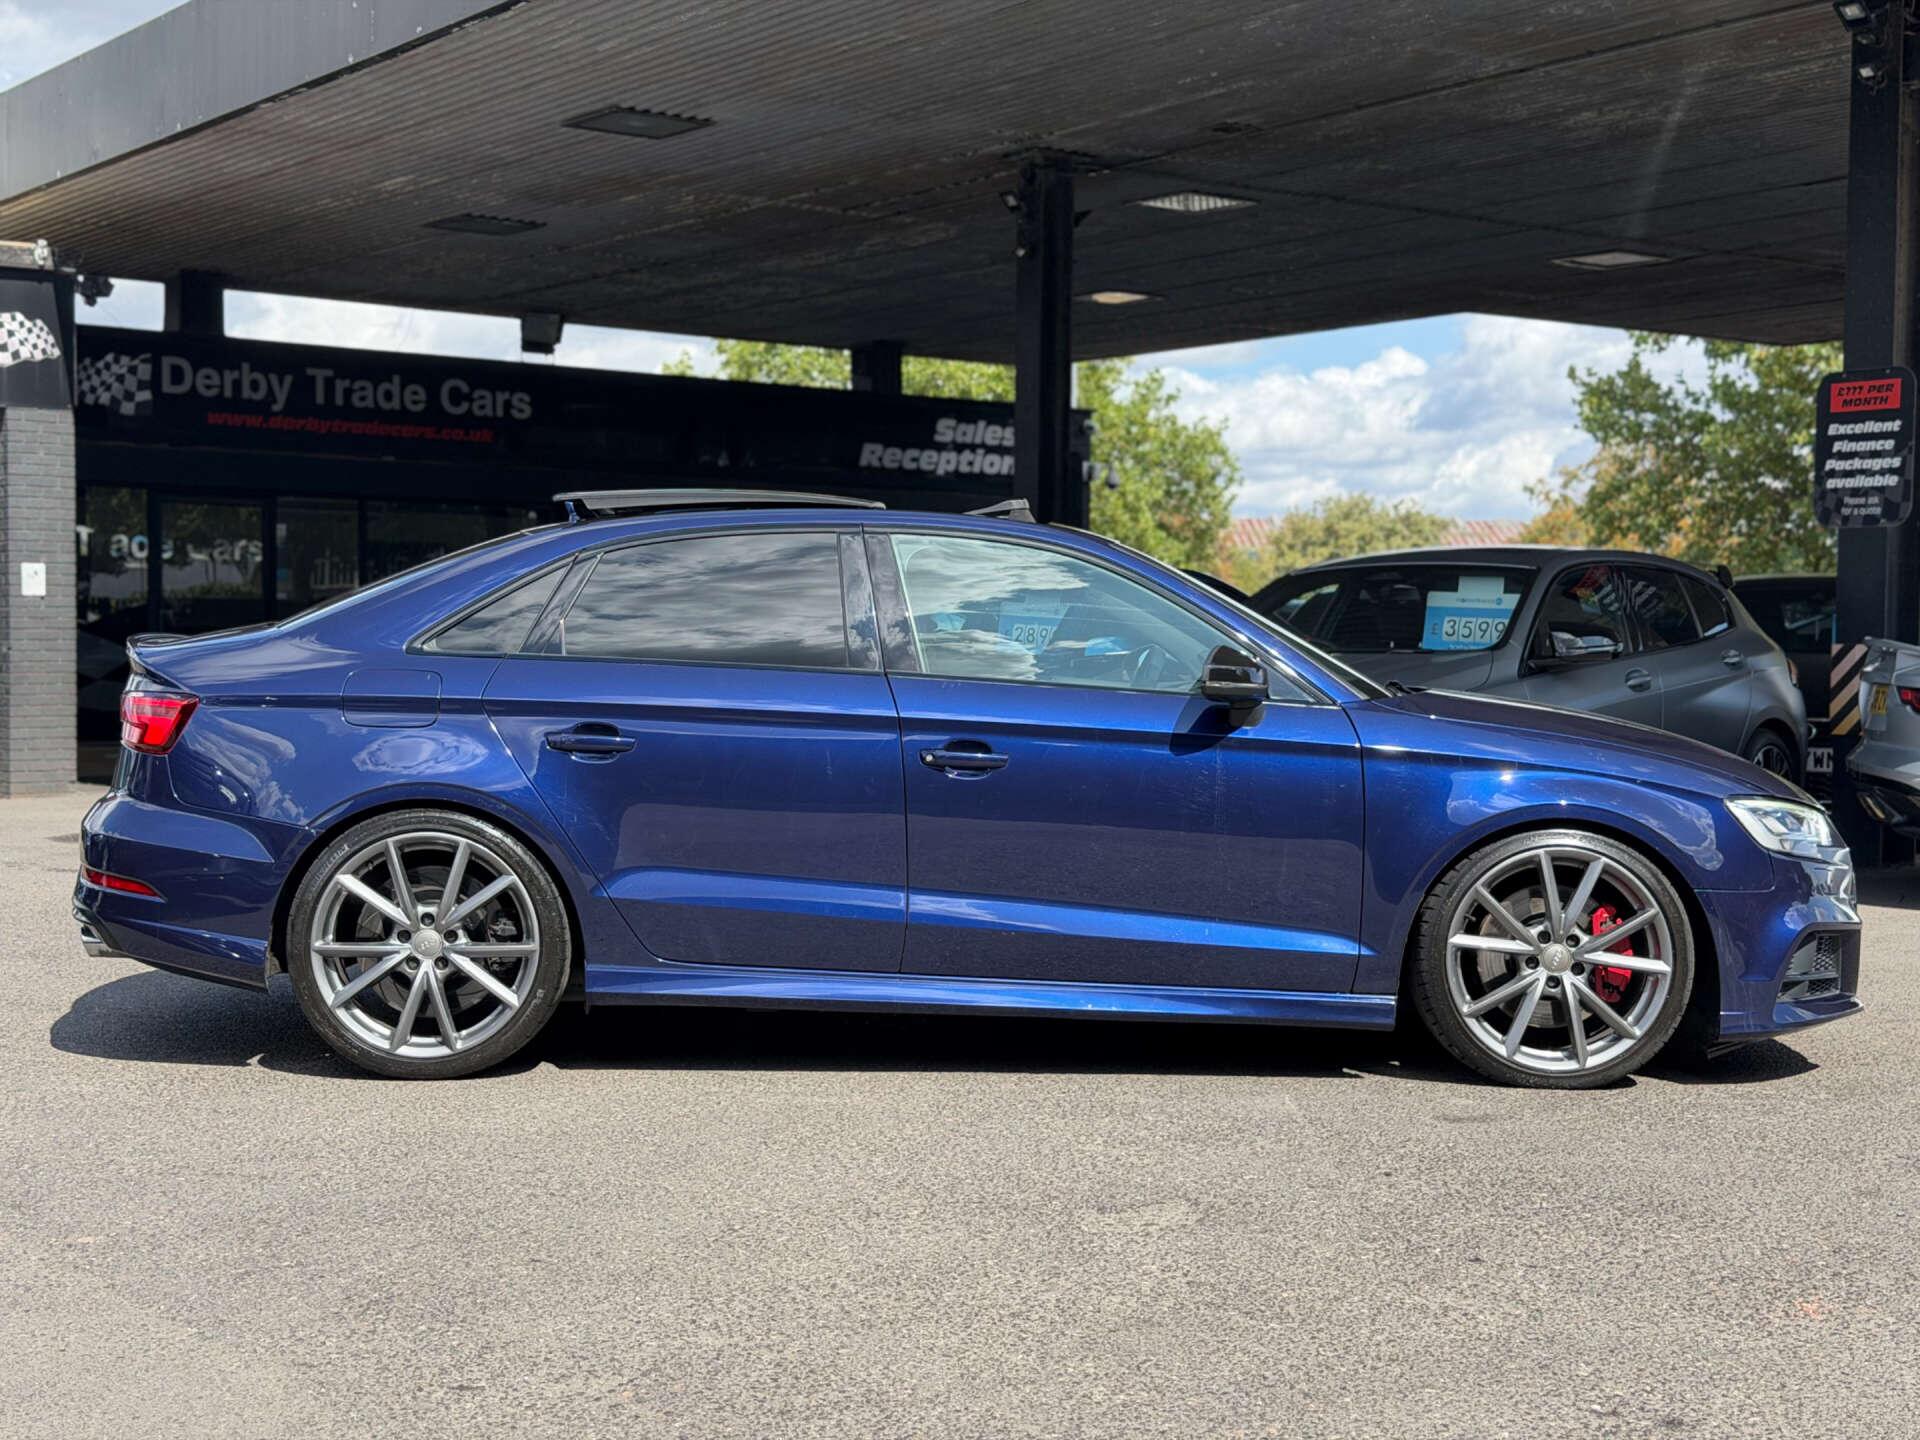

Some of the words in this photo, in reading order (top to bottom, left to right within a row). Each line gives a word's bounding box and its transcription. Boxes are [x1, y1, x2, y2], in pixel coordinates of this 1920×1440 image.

[160, 355, 293, 411] Derby
[306, 367, 427, 413] Trade
[440, 378, 533, 420] Cars
[1867, 383, 1895, 394] PER
[1841, 395, 1889, 408] MONTH
[207, 411, 495, 443] www.derbytradecars.co.uk
[933, 417, 1015, 447] Sales
[1827, 419, 1902, 436] Excellent
[1832, 439, 1895, 453] Finance
[858, 442, 1015, 476] Reception
[1824, 456, 1902, 471] Packages
[1826, 473, 1899, 489] available
